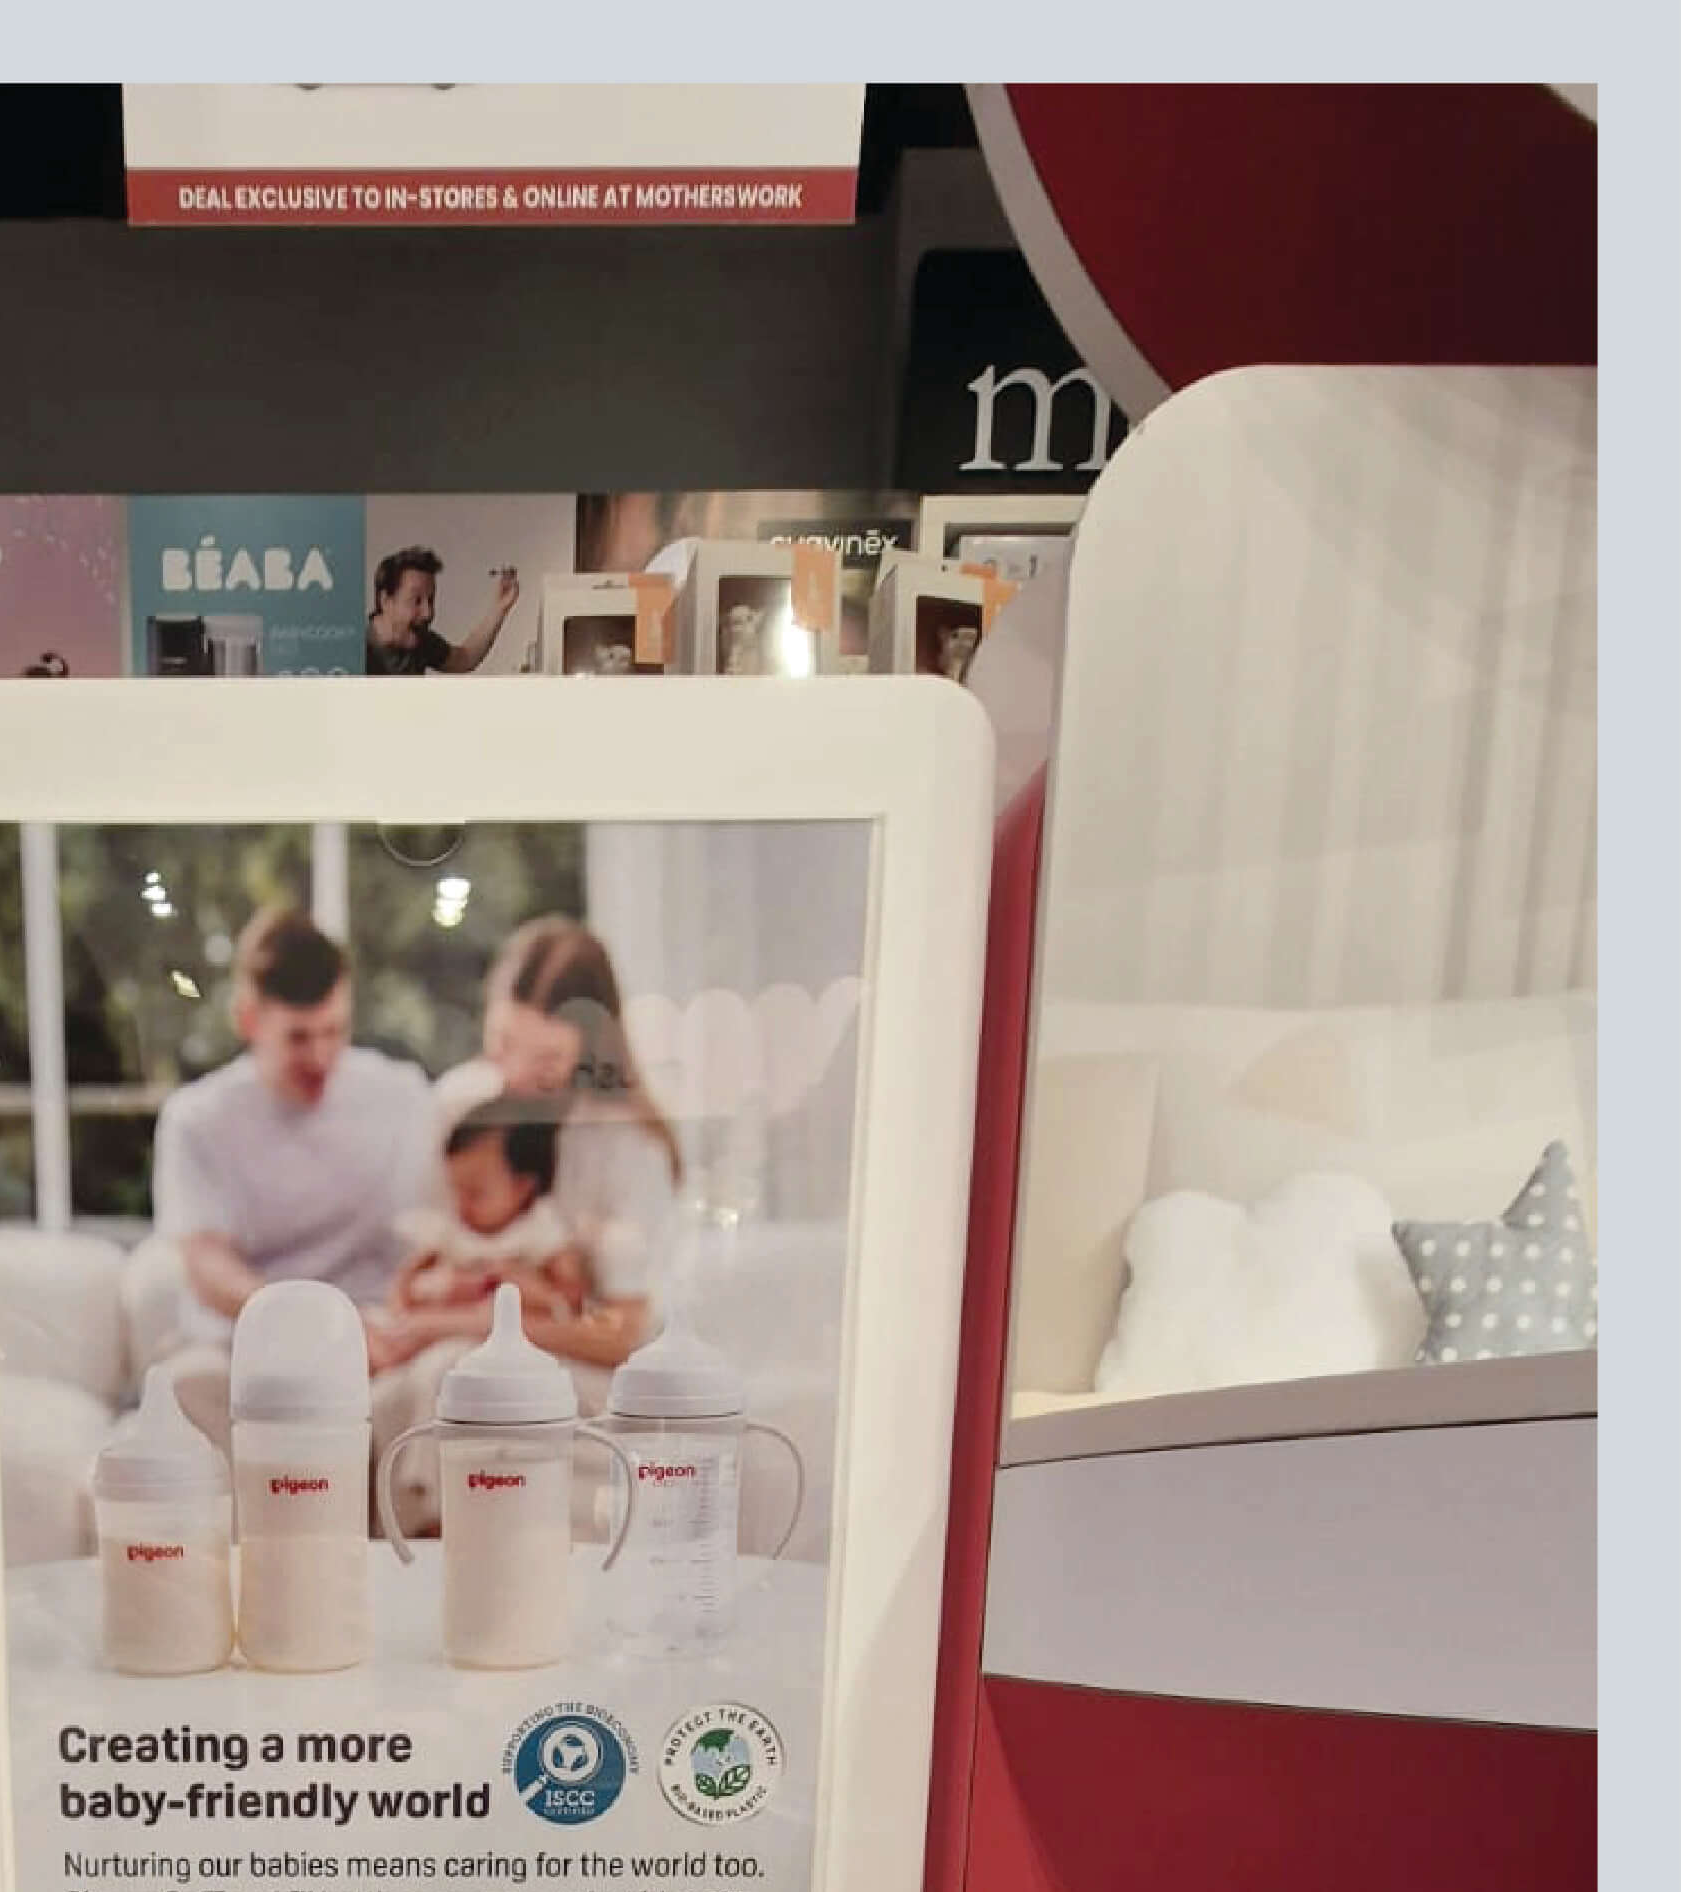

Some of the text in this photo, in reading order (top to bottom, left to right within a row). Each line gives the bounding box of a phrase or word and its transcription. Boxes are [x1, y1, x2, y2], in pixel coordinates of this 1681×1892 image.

[178, 184, 803, 210] DEAL EXCLUSIVE TO IN-STORES & ONLINE AT MOTHERSWORK
[468, 1470, 527, 1493] pigeon
[637, 1461, 698, 1482] pigeon
[268, 1476, 329, 1496] pigeon
[126, 1542, 185, 1562] pigeon
[58, 1725, 413, 1771] Creating a more
[718, 1707, 746, 1726] THE
[747, 1718, 779, 1766] EARTH
[59, 1782, 491, 1828] baby-friendly world
[544, 1789, 596, 1808] ISCC
[64, 1851, 766, 1883] Nurturing our babies means caring for the world too.
